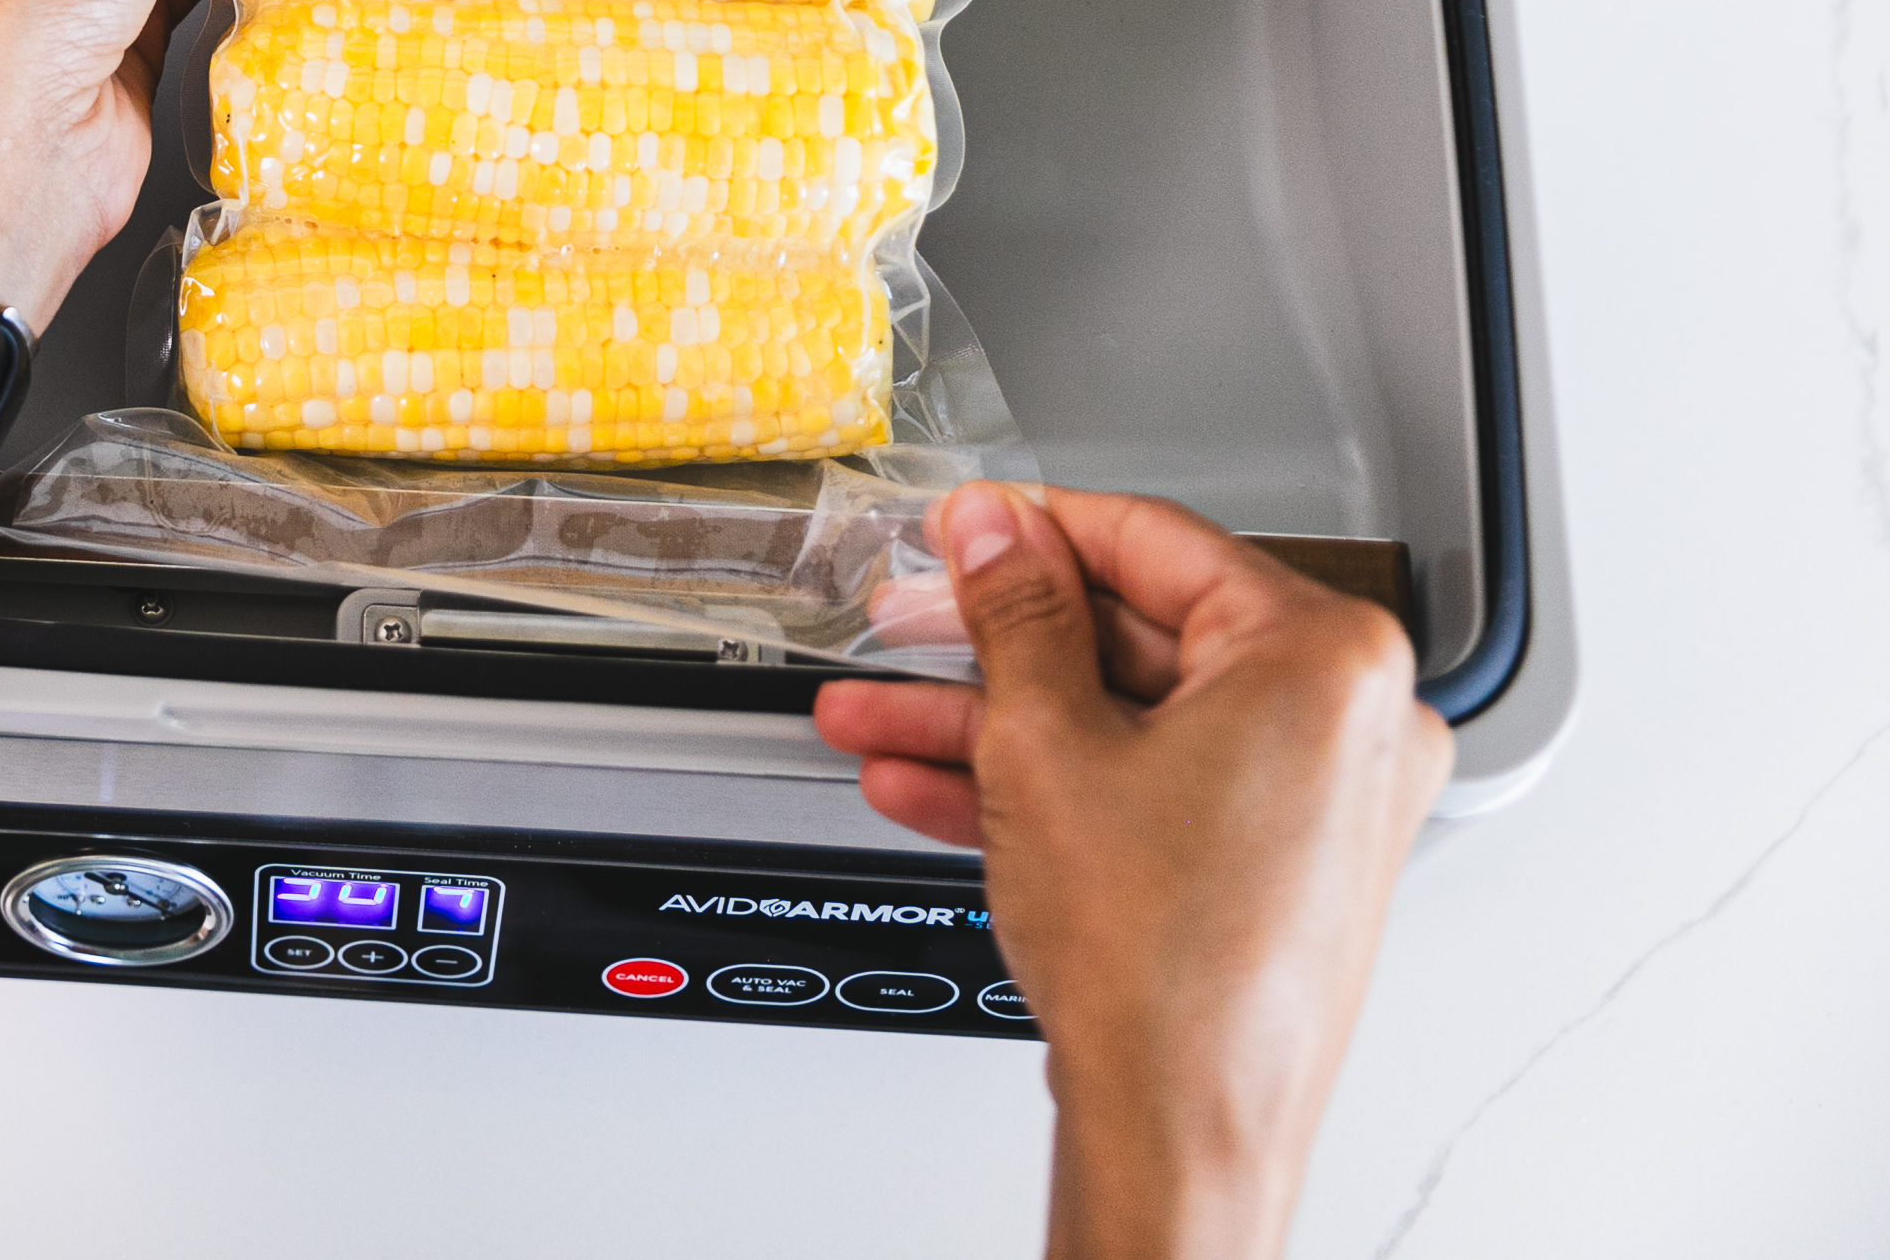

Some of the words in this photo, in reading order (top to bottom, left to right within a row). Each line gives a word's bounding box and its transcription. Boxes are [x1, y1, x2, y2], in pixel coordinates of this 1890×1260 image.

[291, 869, 345, 879] Vacuum
[349, 871, 382, 881] Time
[424, 876, 452, 885] Seal
[455, 878, 489, 888] Time
[658, 893, 759, 915] AVID
[286, 948, 311, 957] SET
[615, 972, 675, 984] CANCEL
[731, 975, 773, 986] AUTO
[776, 978, 807, 988] VAC
[757, 985, 793, 994] SEAL
[879, 987, 915, 997] SEAL
